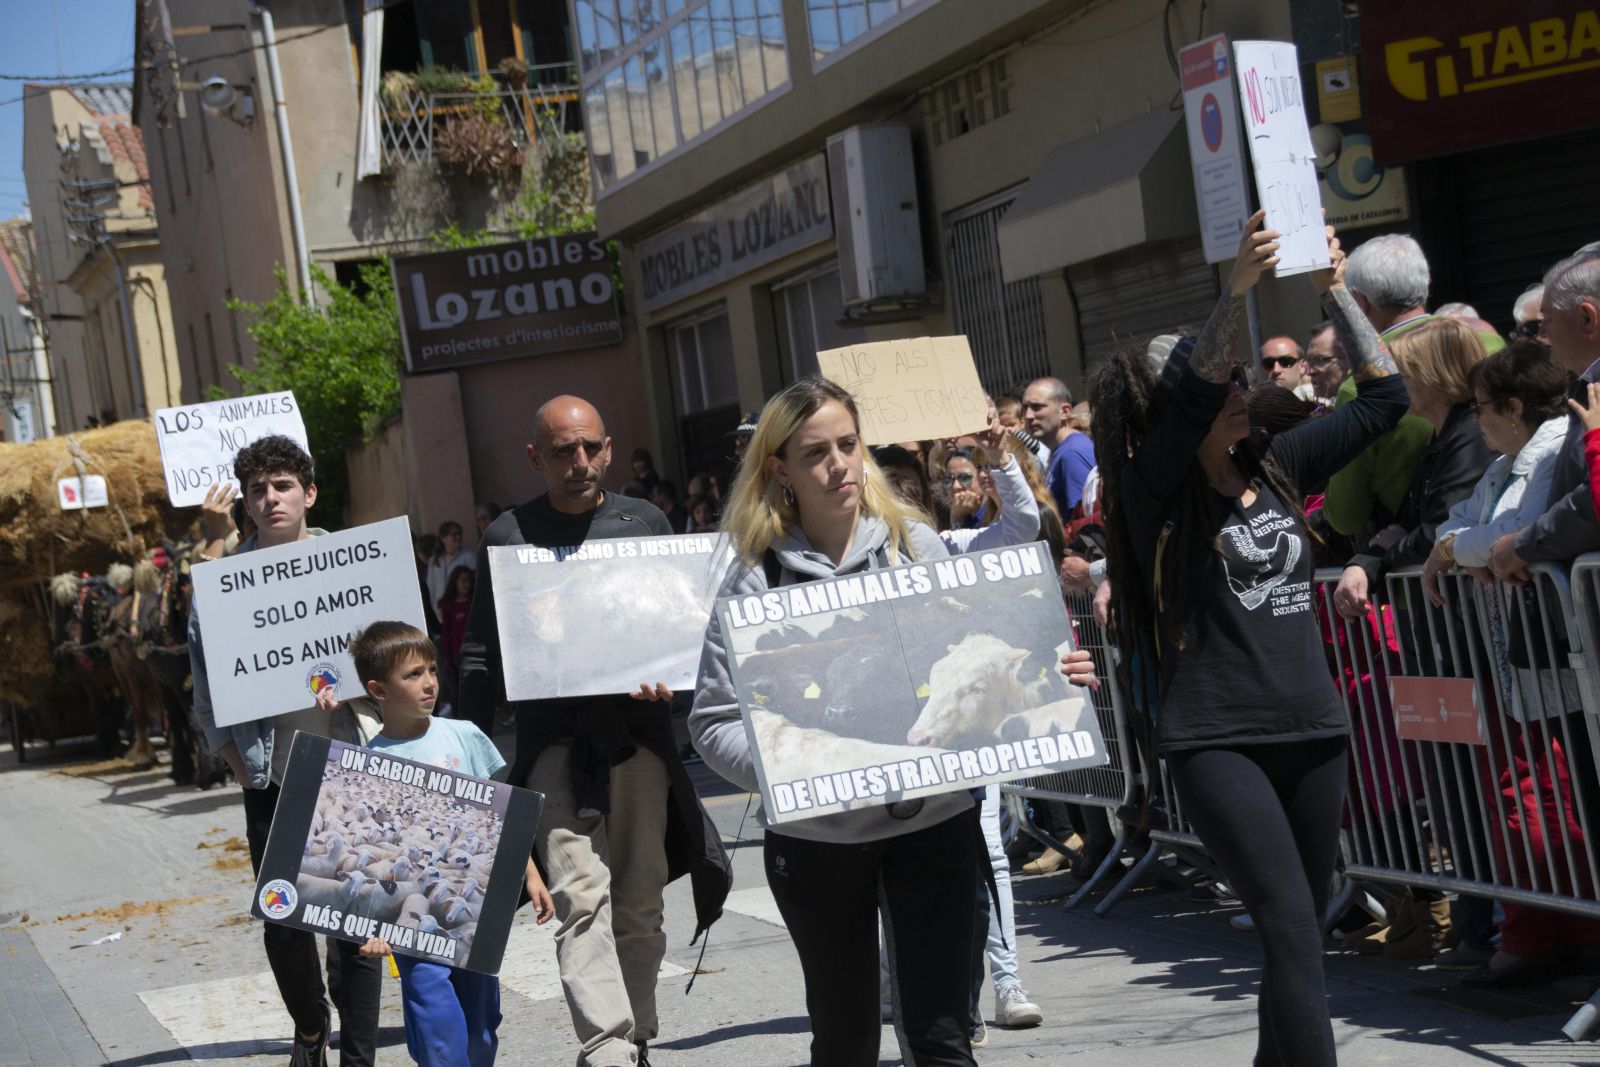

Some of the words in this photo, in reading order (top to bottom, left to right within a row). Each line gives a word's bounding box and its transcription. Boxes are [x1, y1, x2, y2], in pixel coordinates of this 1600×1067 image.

[1459, 9, 1600, 79] TABA
[1244, 67, 1267, 128] NO
[466, 237, 606, 278] mobles
[640, 226, 723, 299] MOBLES
[410, 272, 613, 331] Lozano
[421, 336, 500, 360] projectes
[504, 318, 619, 346] d'interiorisme
[840, 351, 877, 378] NO
[895, 349, 929, 374] ALS
[159, 408, 203, 434] LOS
[219, 396, 293, 423] ANIMALES
[862, 393, 908, 426] RES
[219, 426, 247, 452] NO
[172, 466, 212, 494] NOS
[216, 462, 236, 482] PE
[1251, 516, 1296, 538] BERATION
[220, 569, 256, 593] SIN
[262, 540, 388, 585] PREJUICIOS,
[517, 543, 615, 564] VEGANISMO
[616, 541, 638, 558] ES
[640, 537, 714, 556] JUSTICIA
[253, 600, 308, 629] SOLO
[315, 585, 374, 616] AMOR
[728, 591, 786, 629] LOS
[790, 564, 933, 618] ANIMALES
[934, 556, 981, 590] NO
[984, 546, 1043, 583] SON
[1270, 595, 1290, 607] THE
[1272, 602, 1310, 617] INDUSTR
[233, 656, 249, 677] A
[253, 646, 294, 672] LOS
[301, 632, 351, 662] ANIM
[340, 748, 367, 771] UN
[367, 755, 426, 788] SABOR
[427, 769, 453, 794] NO
[454, 776, 495, 806] VALE
[773, 783, 812, 815] DE
[812, 754, 942, 804] NUESTRA
[941, 731, 1096, 783] PROPIEDAD
[302, 903, 342, 931] MÁS
[343, 914, 377, 940] QUE
[379, 922, 413, 950] UNA
[413, 931, 457, 960] VIDA
